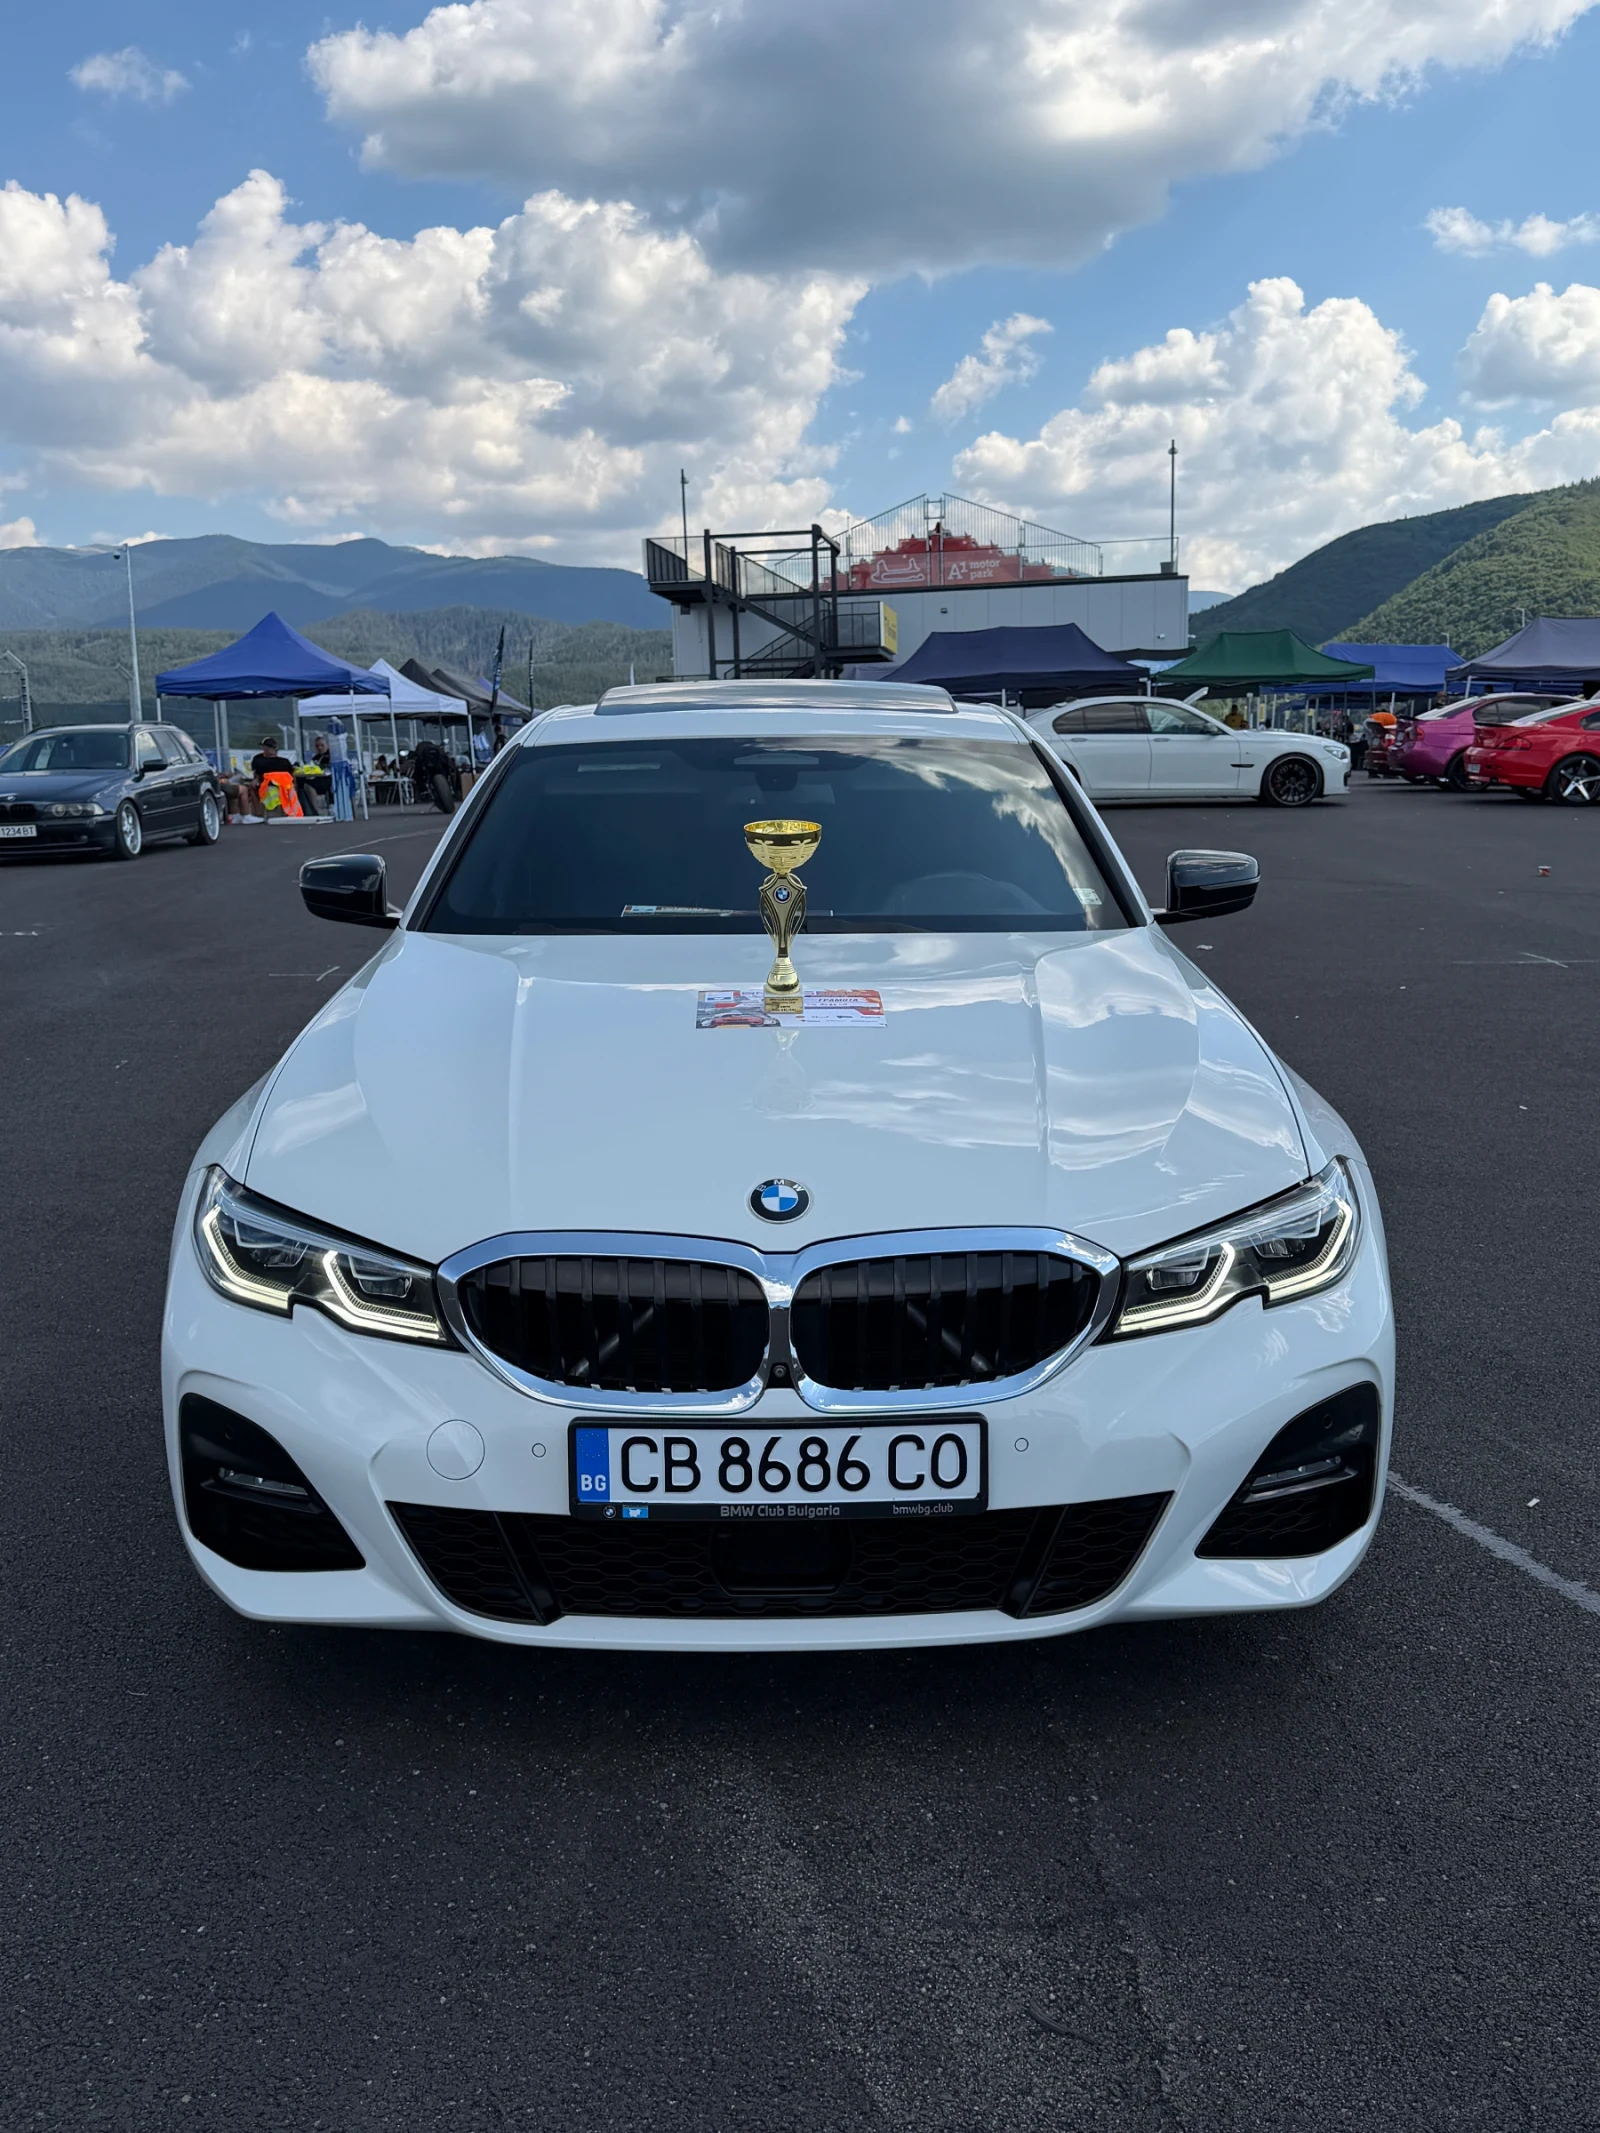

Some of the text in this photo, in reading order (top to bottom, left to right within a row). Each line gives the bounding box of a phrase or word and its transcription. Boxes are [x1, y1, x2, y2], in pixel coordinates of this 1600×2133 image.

[948, 560, 1000, 580] A1 motor
[970, 569, 993, 580] park
[1, 827, 21, 836] 1234
[756, 1179, 805, 1192] BMW
[621, 1436, 701, 1493] CB
[718, 1436, 870, 1493] 8686
[580, 1474, 606, 1491] BG
[720, 1504, 840, 1519] BMW Club Bulgaria
[893, 1503, 953, 1516] bmwbg.club
